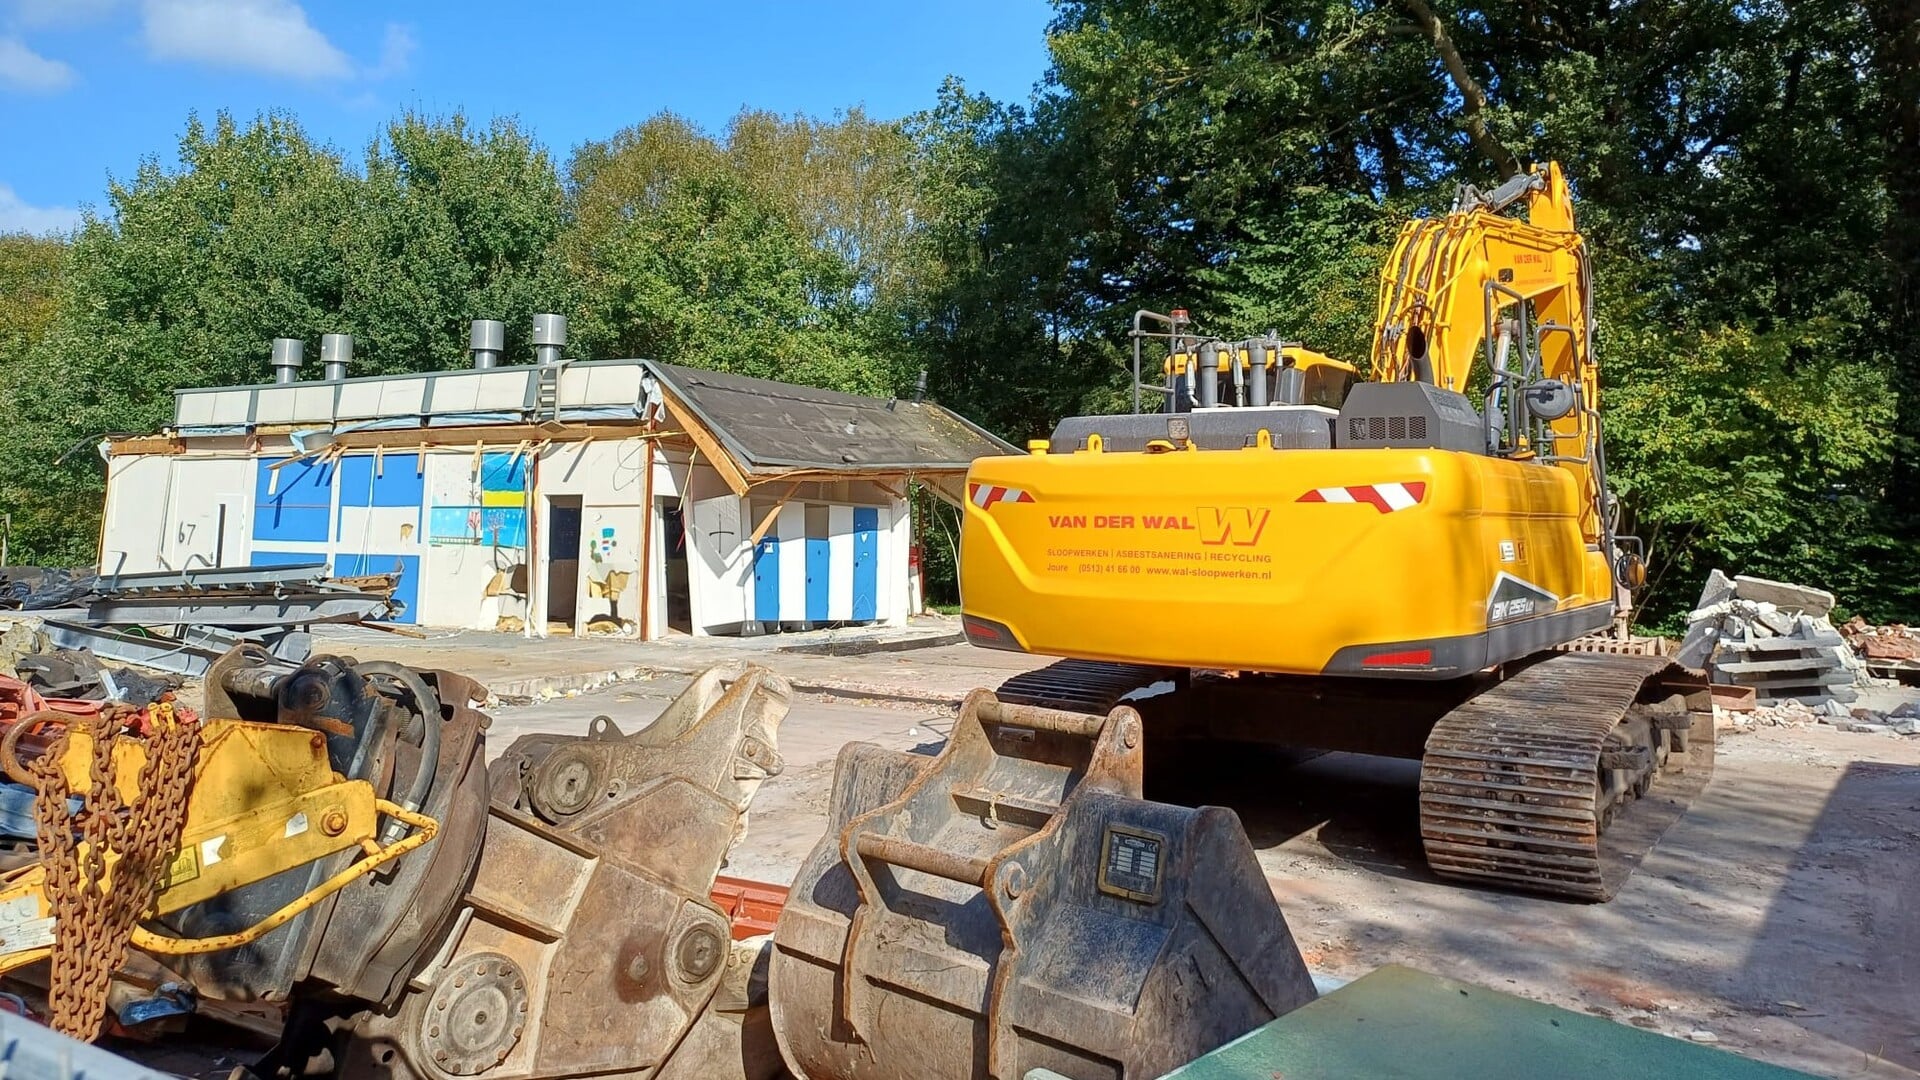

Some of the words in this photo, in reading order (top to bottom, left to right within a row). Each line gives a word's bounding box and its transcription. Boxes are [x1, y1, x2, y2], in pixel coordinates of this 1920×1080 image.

[1048, 515, 1087, 529] VAN
[1093, 515, 1135, 529] DER
[1142, 515, 1196, 530] WAL
[178, 520, 197, 546] 67
[1047, 548, 1109, 558] SLOOPWERKEN
[1116, 550, 1202, 561] ASBESTSANERING
[1210, 553, 1272, 563] RECYCLING
[1047, 563, 1069, 572] Joure
[1078, 563, 1104, 574] (0513)
[1105, 565, 1115, 573] 41
[1117, 565, 1128, 574] 66
[1130, 566, 1141, 574] 00
[1146, 566, 1272, 580] www.wal-sloopwerken.nl
